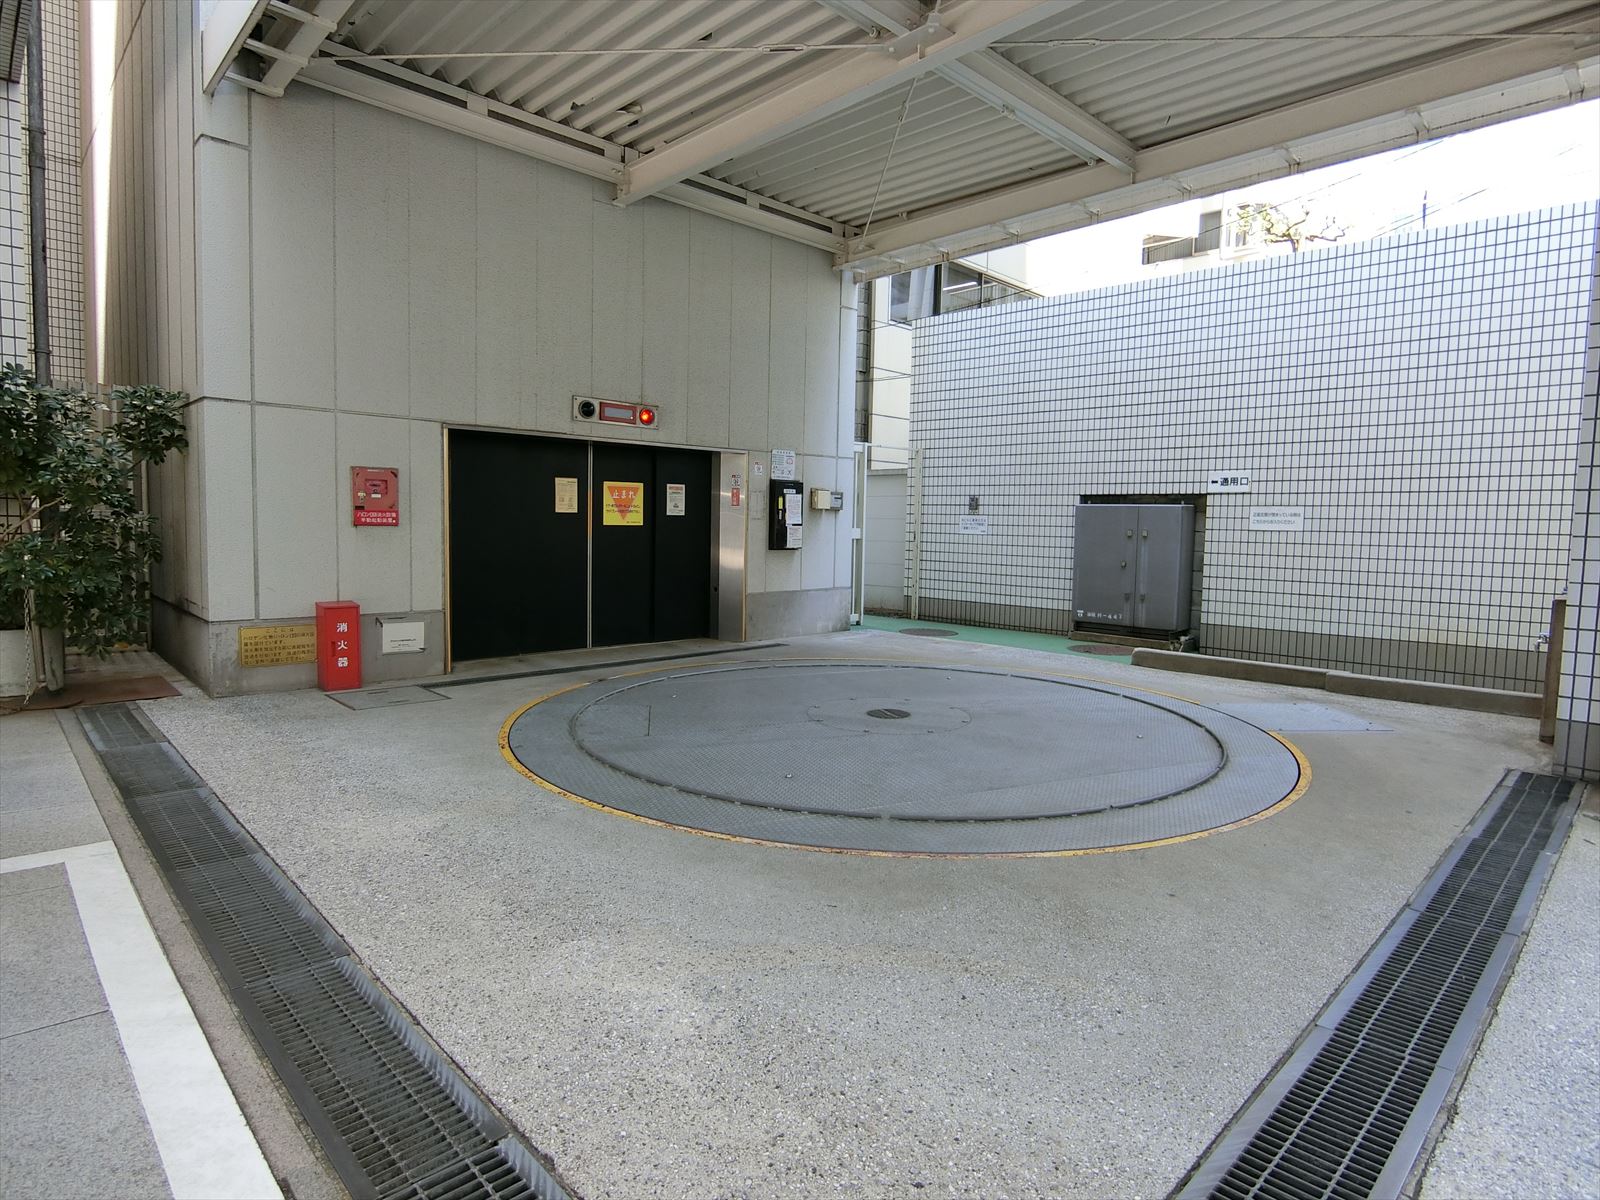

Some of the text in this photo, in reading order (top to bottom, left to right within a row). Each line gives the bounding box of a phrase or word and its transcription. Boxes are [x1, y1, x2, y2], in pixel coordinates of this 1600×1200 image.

[1220, 476, 1249, 486] 通用口
[612, 489, 636, 499] 止まれ
[336, 622, 349, 668] 消火器
